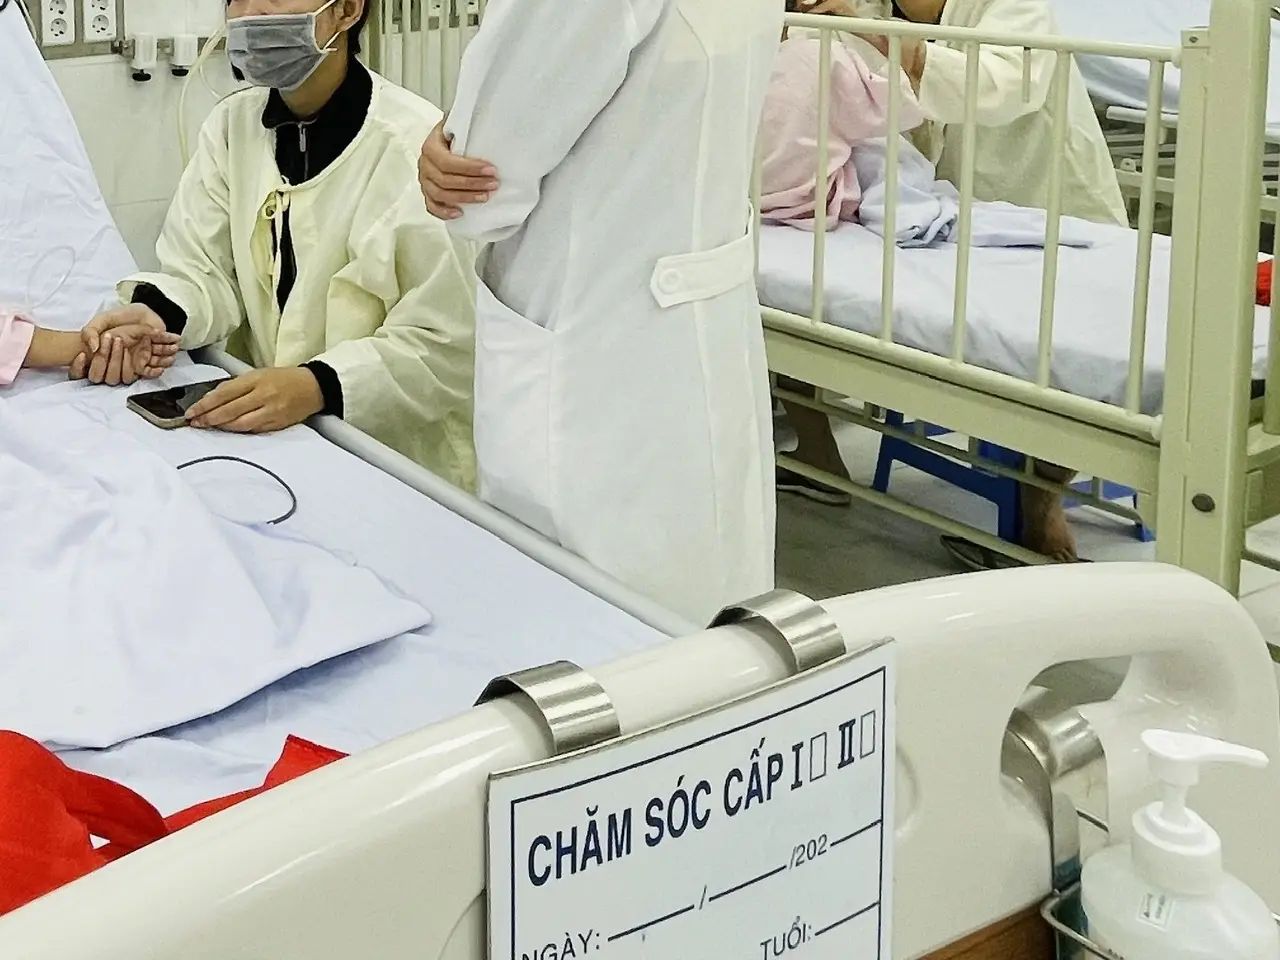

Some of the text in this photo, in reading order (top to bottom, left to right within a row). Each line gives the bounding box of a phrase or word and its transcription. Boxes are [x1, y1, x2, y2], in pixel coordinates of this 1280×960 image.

[527, 804, 632, 888] CHĂM
[644, 774, 711, 848] SÓC
[723, 736, 783, 818] CẤP
[790, 741, 805, 793] I
[760, 915, 813, 960] TUỔI:
